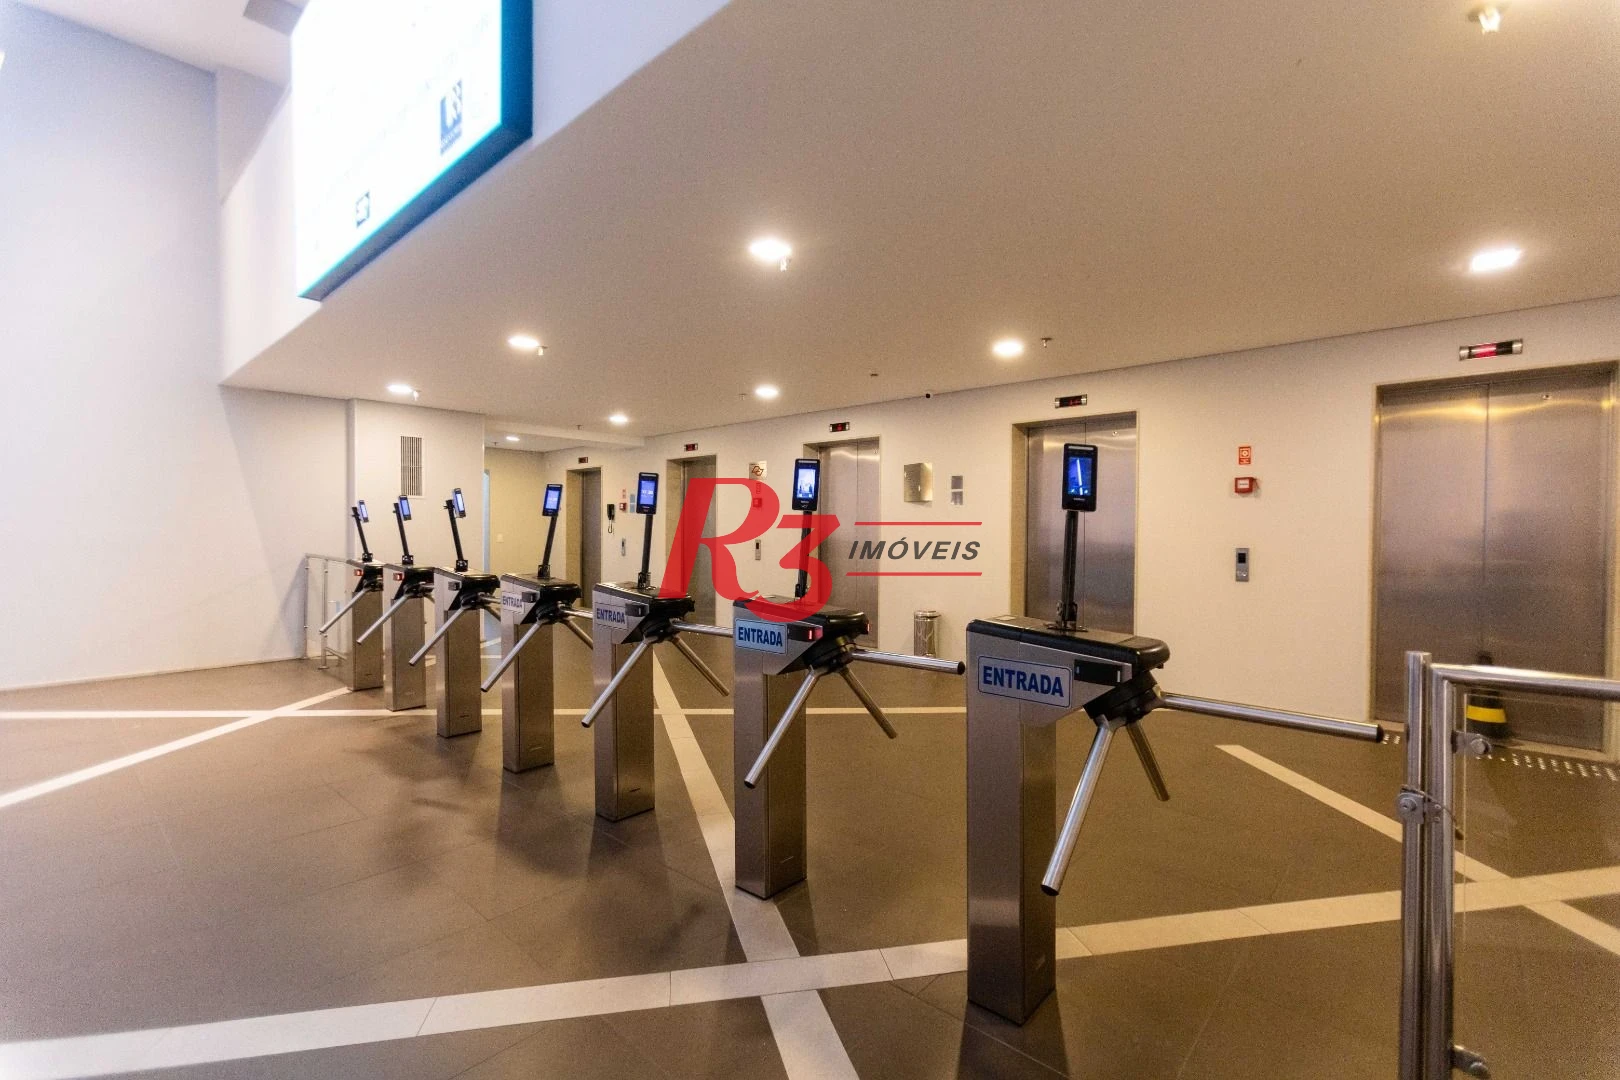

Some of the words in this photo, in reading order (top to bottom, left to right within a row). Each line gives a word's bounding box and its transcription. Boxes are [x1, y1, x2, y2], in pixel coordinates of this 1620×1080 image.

[597, 607, 625, 625] ENTRADA
[738, 626, 783, 648] ENTRADA
[983, 665, 1064, 697] ENTRADA
